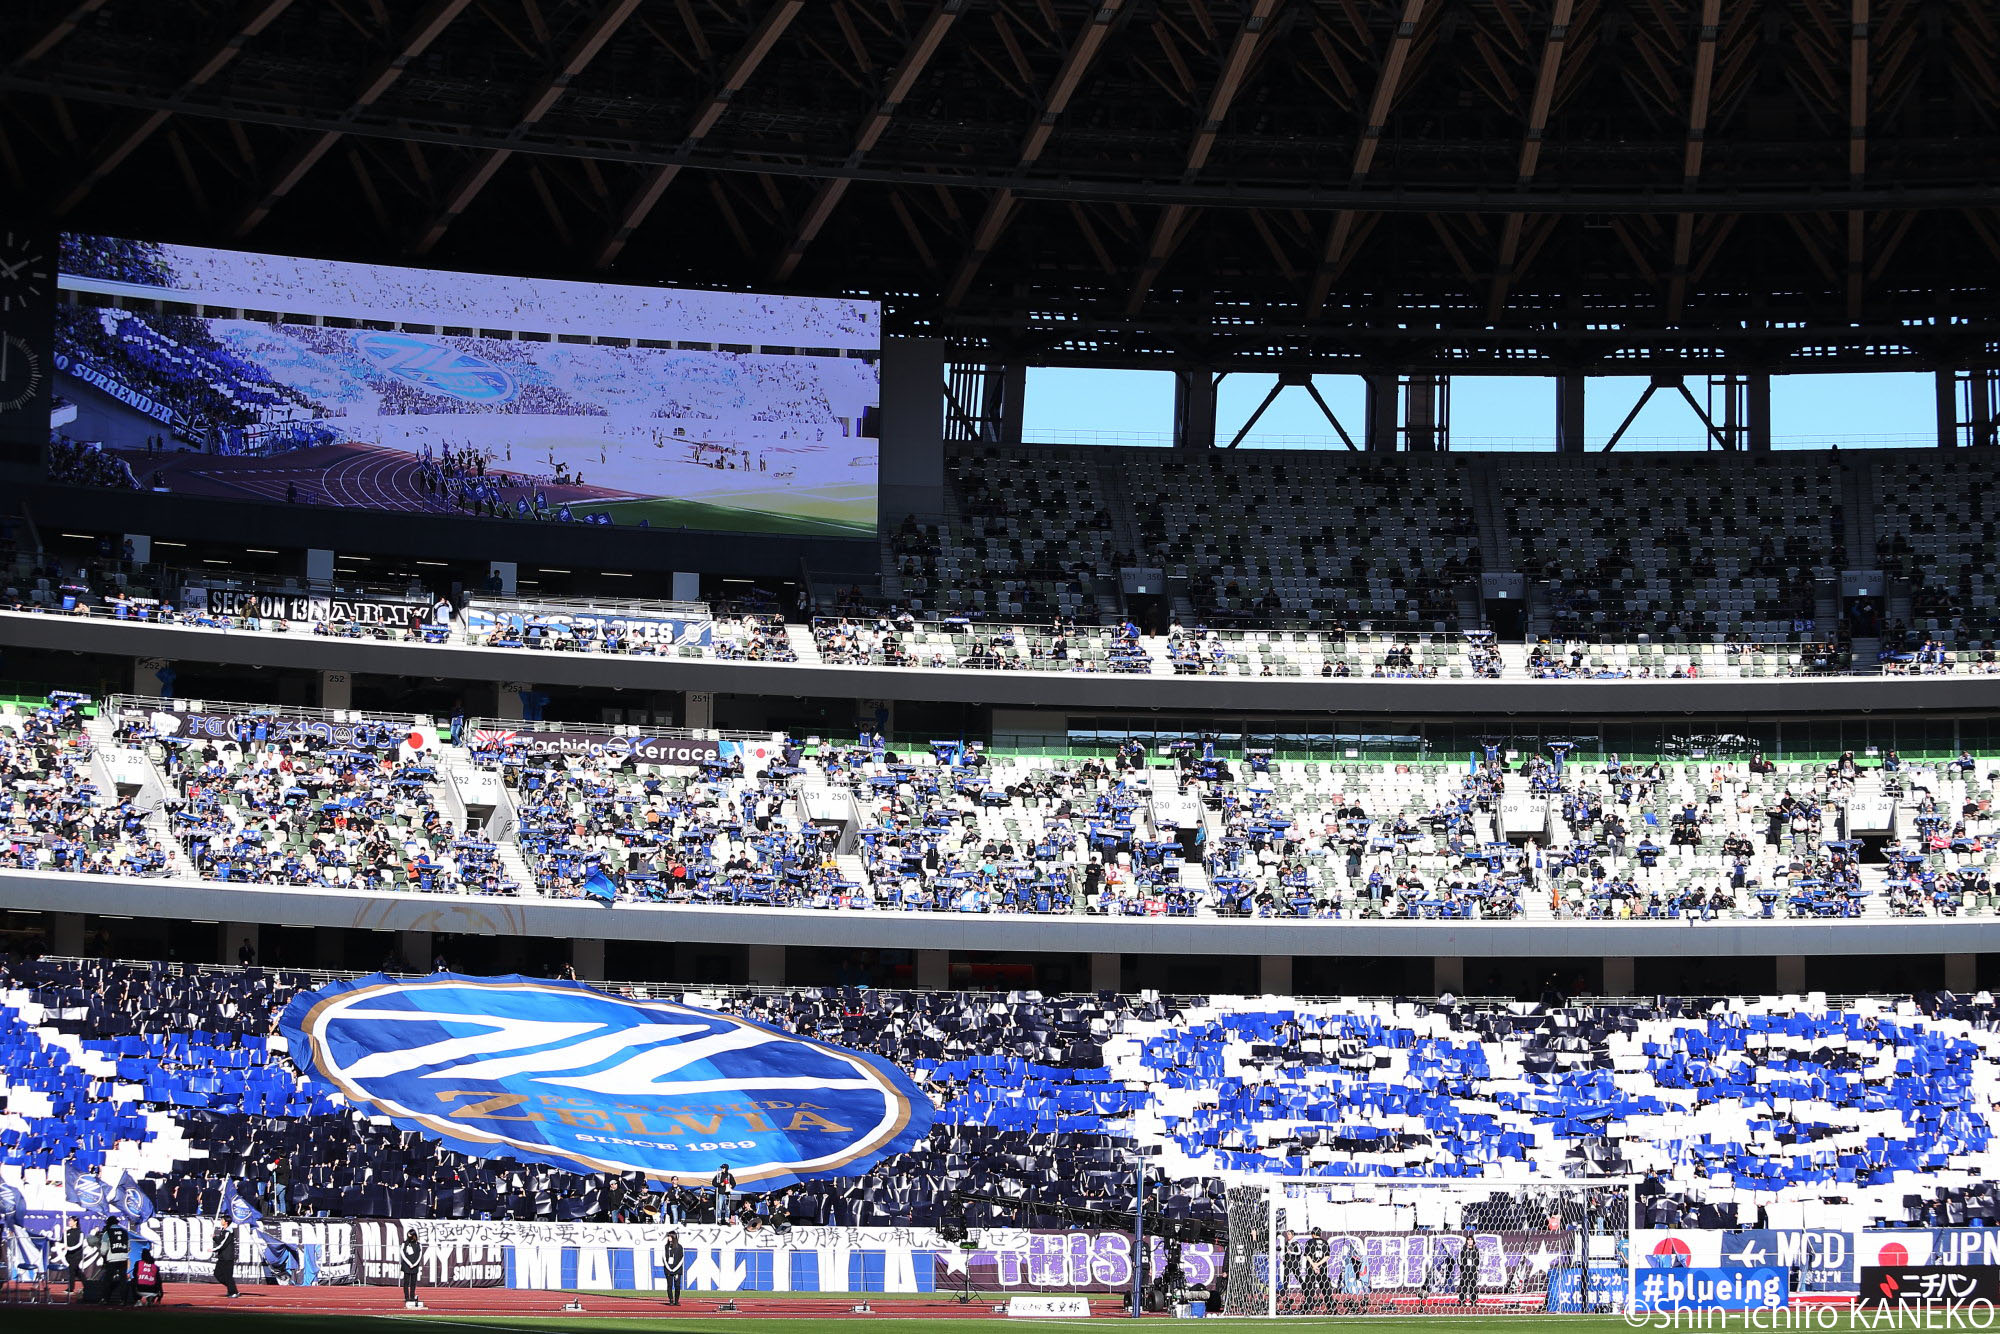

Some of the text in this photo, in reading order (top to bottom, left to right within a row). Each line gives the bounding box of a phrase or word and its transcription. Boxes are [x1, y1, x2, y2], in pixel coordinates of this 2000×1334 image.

[72, 363, 174, 424] SURRENDER
[211, 590, 286, 619] SECON
[290, 597, 308, 622] 13
[329, 674, 345, 683] 252
[128, 756, 144, 764] 252
[529, 737, 717, 761] achida terrace
[453, 776, 497, 786] 252 251
[804, 792, 848, 801] 251 250
[1154, 802, 1197, 810] 250 249
[1850, 803, 1893, 811] 248 247
[1503, 805, 1545, 813] 249 248
[436, 1090, 854, 1135] ZELVIA
[575, 1133, 757, 1153] SINCE 1989
[141, 1216, 267, 1263] SOUH
[1776, 1231, 1845, 1268] MCD
[1942, 1230, 2000, 1266] JPN
[363, 1262, 381, 1278] THE
[454, 1265, 483, 1281] SOUTH
[484, 1265, 502, 1280] END
[994, 1233, 1132, 1286] THIS
[1642, 1272, 1781, 1306] #blueing
[1900, 1273, 1978, 1298] ニチバン
